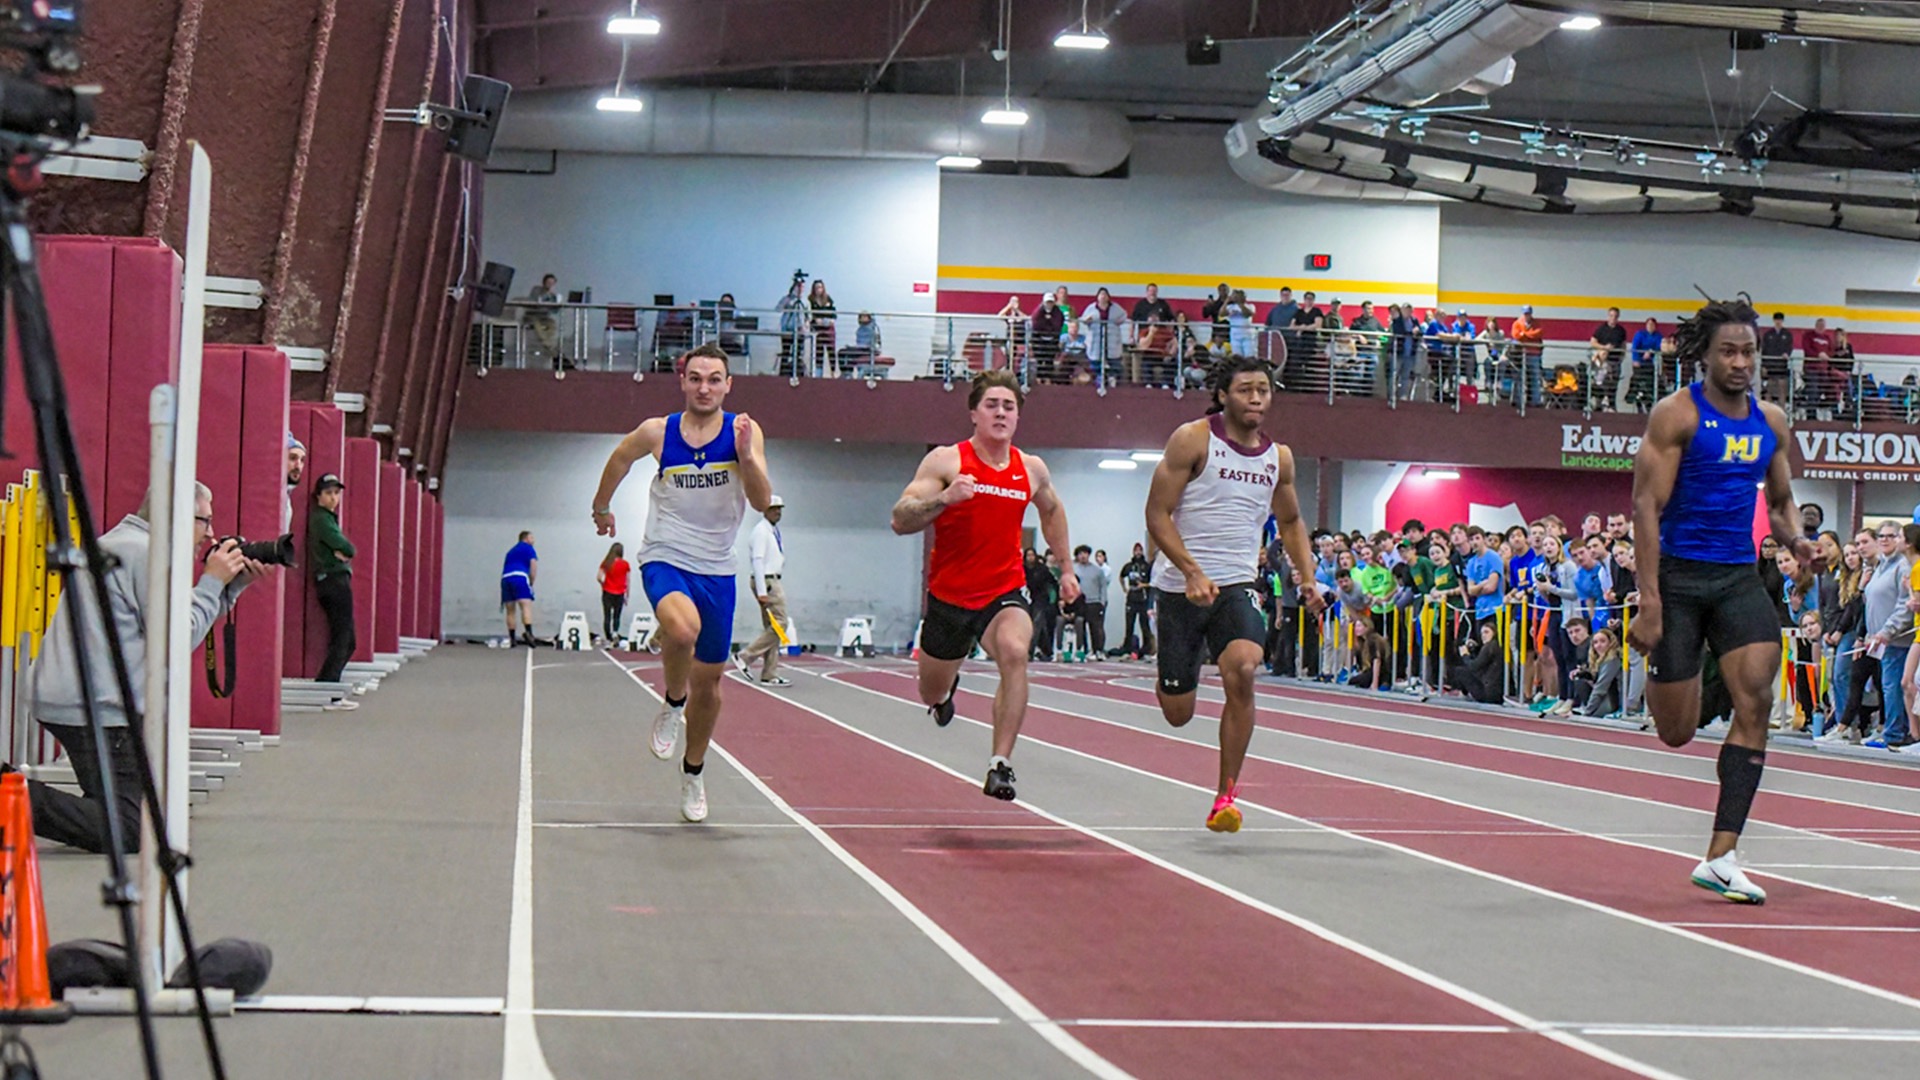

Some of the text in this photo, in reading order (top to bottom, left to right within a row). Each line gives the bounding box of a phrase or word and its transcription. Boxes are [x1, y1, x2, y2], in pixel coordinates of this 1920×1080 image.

[673, 469, 730, 489] WIDENER
[1218, 467, 1273, 487] EASTERN
[1803, 469, 1860, 480] FEDERAL
[1863, 472, 1909, 481] CREDIT
[568, 627, 580, 643] 8
[637, 629, 650, 645] 7
